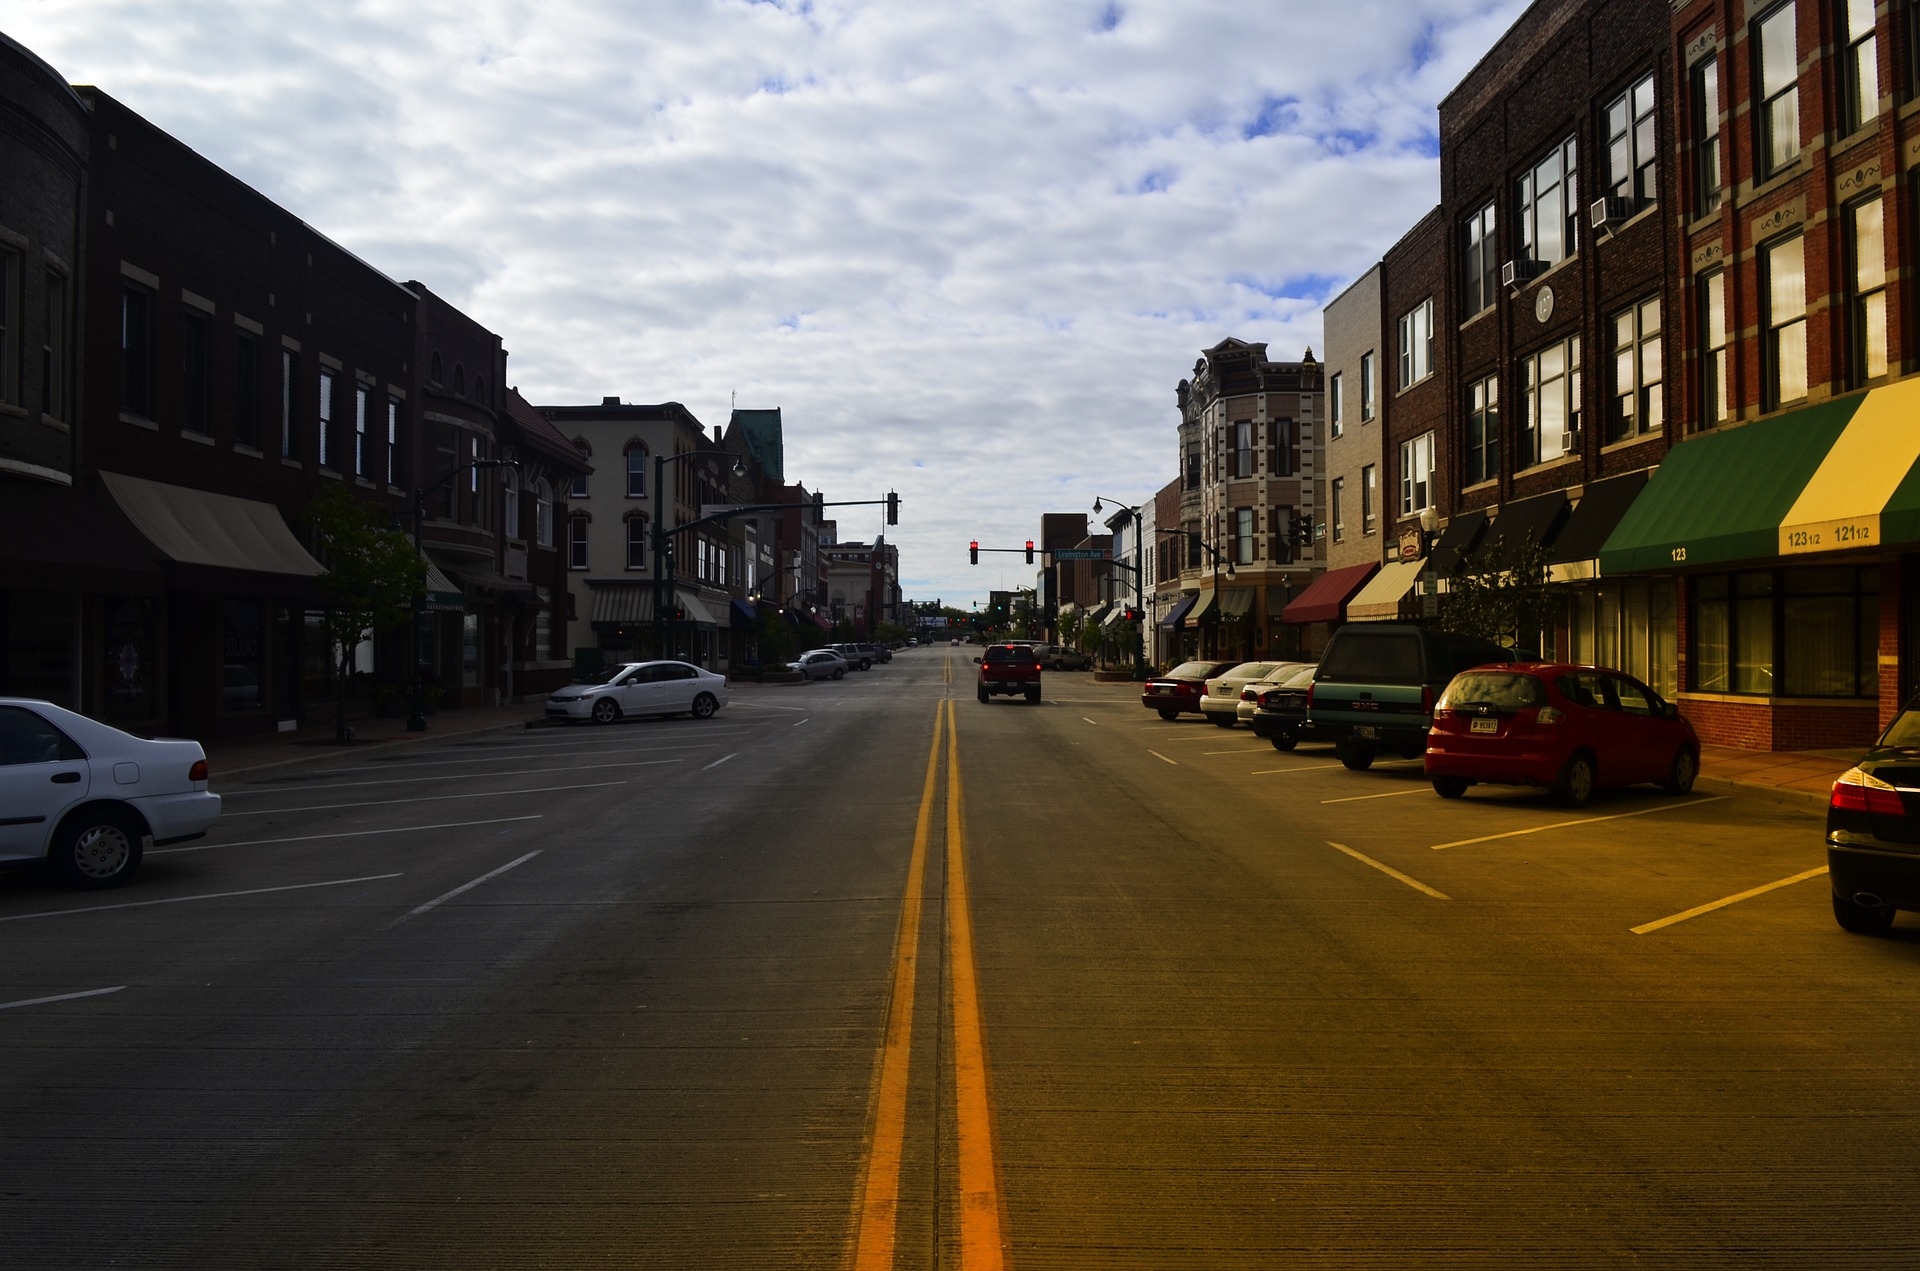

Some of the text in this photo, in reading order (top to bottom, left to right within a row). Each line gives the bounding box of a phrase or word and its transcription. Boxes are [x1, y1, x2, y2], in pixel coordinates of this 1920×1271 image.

[1058, 550, 1089, 559] Lexington
[1090, 550, 1102, 559] Ave
[1671, 547, 1687, 562] 123
